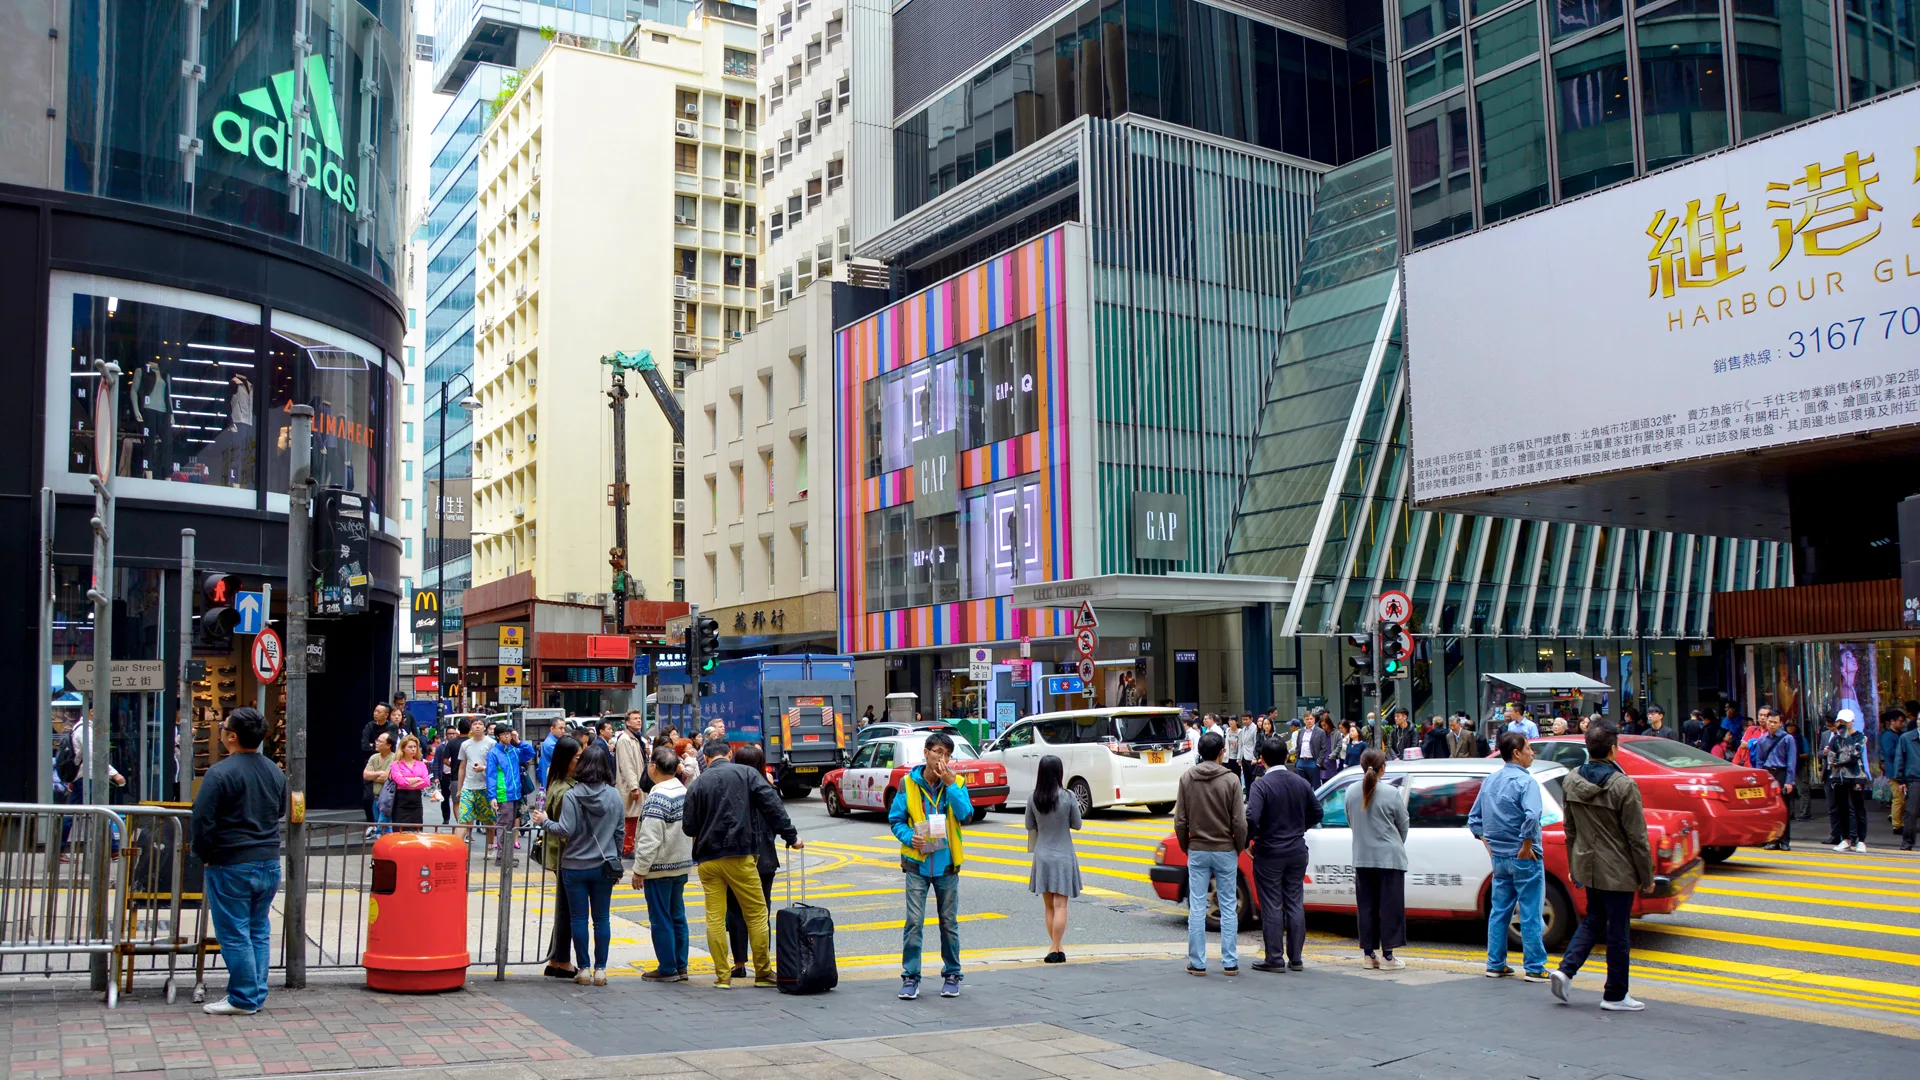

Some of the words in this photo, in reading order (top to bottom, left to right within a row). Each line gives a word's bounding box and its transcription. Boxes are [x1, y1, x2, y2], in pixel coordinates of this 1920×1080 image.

[1645, 146, 1920, 299] 維港
[1667, 271, 1845, 332] HARBOUR
[1788, 317, 1866, 359] 3167
[77, 388, 181, 409] MDE
[77, 421, 150, 437] FR
[311, 410, 375, 449] LIMAHEAT
[76, 454, 235, 478] NRMAL
[921, 455, 947, 496] GAP
[1146, 510, 1177, 541] GAP
[1056, 583, 1094, 598] TOWER
[734, 609, 785, 631] 萬邦行
[86, 664, 129, 672] Duilar
[132, 663, 161, 672] Street
[111, 676, 151, 686] 己立街
[1315, 875, 1356, 885] ELECTR
